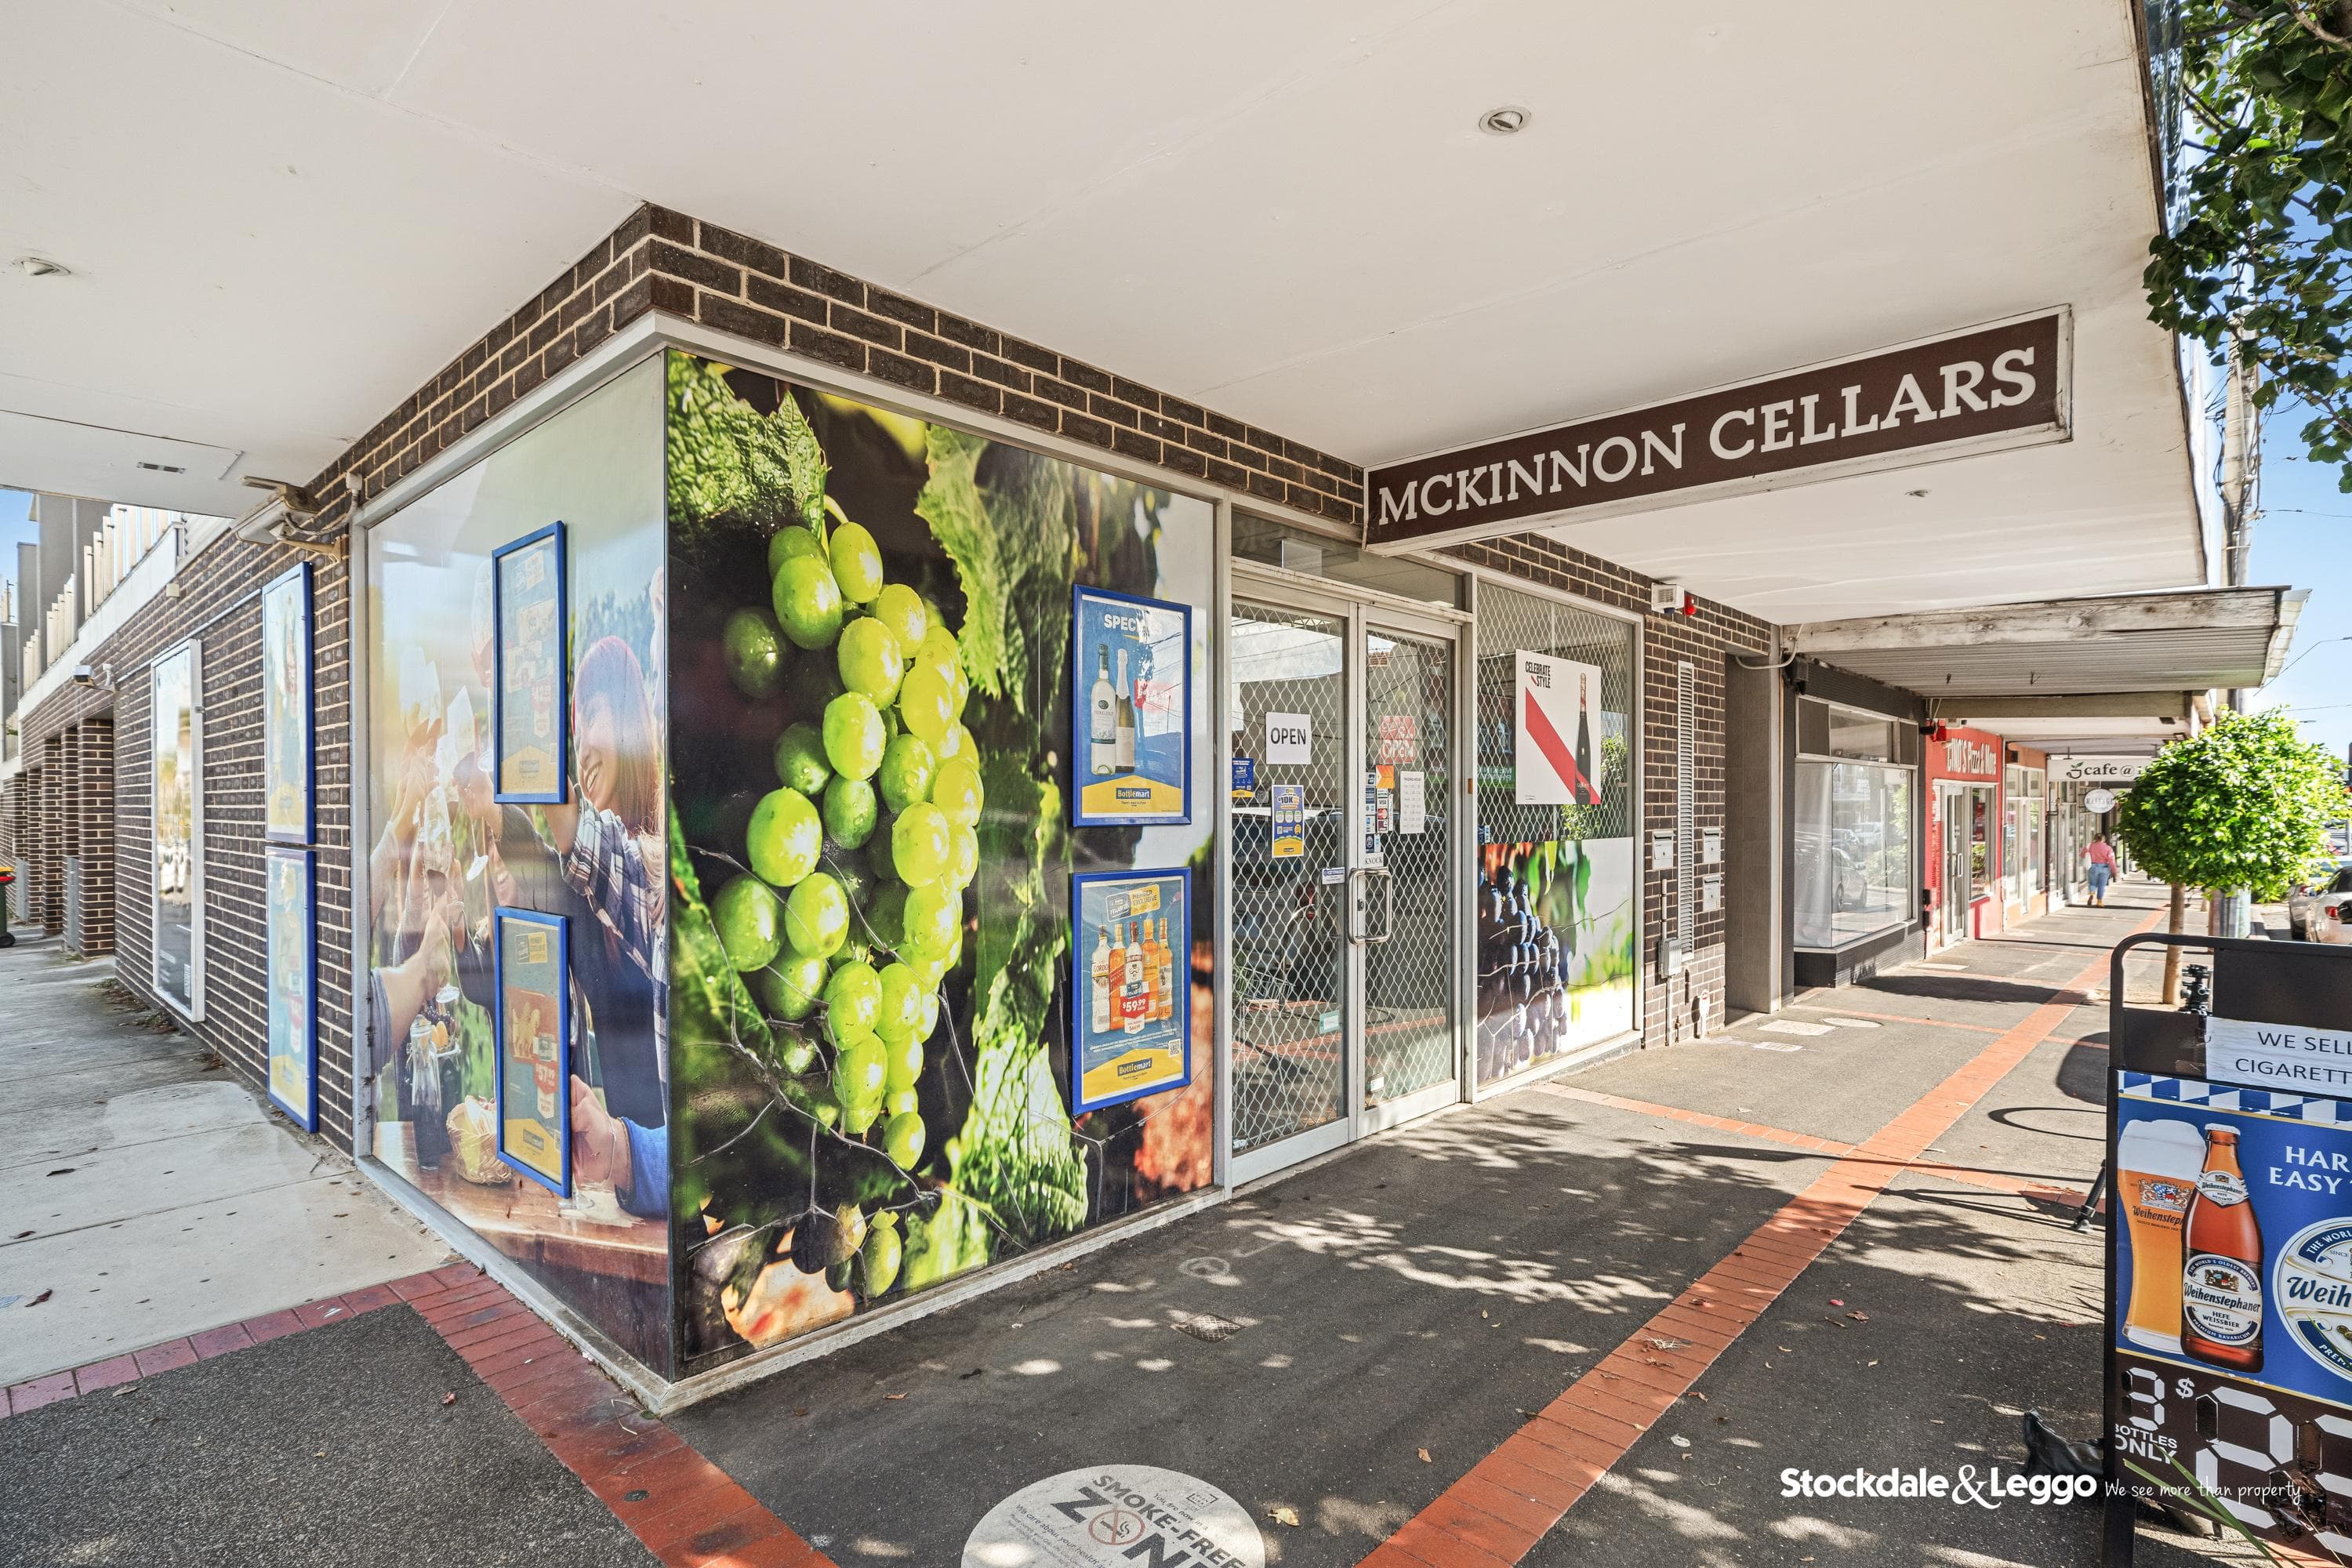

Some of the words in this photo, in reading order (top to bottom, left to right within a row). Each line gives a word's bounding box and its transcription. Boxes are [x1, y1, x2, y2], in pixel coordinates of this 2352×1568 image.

[1378, 422, 1686, 526] MCKINNON
[1709, 346, 2037, 460] CELLARS
[1525, 661, 1551, 677] CELEBRATE
[1536, 675, 1551, 688] STYLE
[1270, 727, 1307, 746] OPEN
[2084, 763, 2118, 775] cafe
[1117, 789, 1150, 798] Bottlemart
[1122, 998, 1146, 1013] $59.99
[2257, 1031, 2296, 1049] WE
[2304, 1036, 2352, 1055] SELL
[1118, 1060, 1151, 1075] Bottlemart
[2235, 1058, 2352, 1085] CIGARETT
[2285, 1145, 2350, 1173] HAR
[2270, 1167, 2343, 1195] EASY
[2306, 1240, 2324, 1254] THE
[2321, 1230, 2352, 1243] WORL
[2218, 1261, 2239, 1271] OLDEST
[2183, 1283, 2261, 1313] Weihenstephaner
[2287, 1276, 2352, 1308] Weih
[2202, 1314, 2240, 1328] WEISSBIER
[2212, 1311, 2231, 1320] HEFE
[2318, 1344, 2350, 1368] PREM
[2114, 1434, 2177, 1465] ONLY
[1153, 1493, 1167, 1505] You
[1167, 1502, 1179, 1512] are
[1179, 1511, 1195, 1521] now
[1015, 1504, 1027, 1515] We
[1026, 1513, 1041, 1524] care
[1040, 1523, 1060, 1538] about
[1058, 1537, 1076, 1548] your
[1091, 1475, 1246, 1568] SMOKE-FREE
